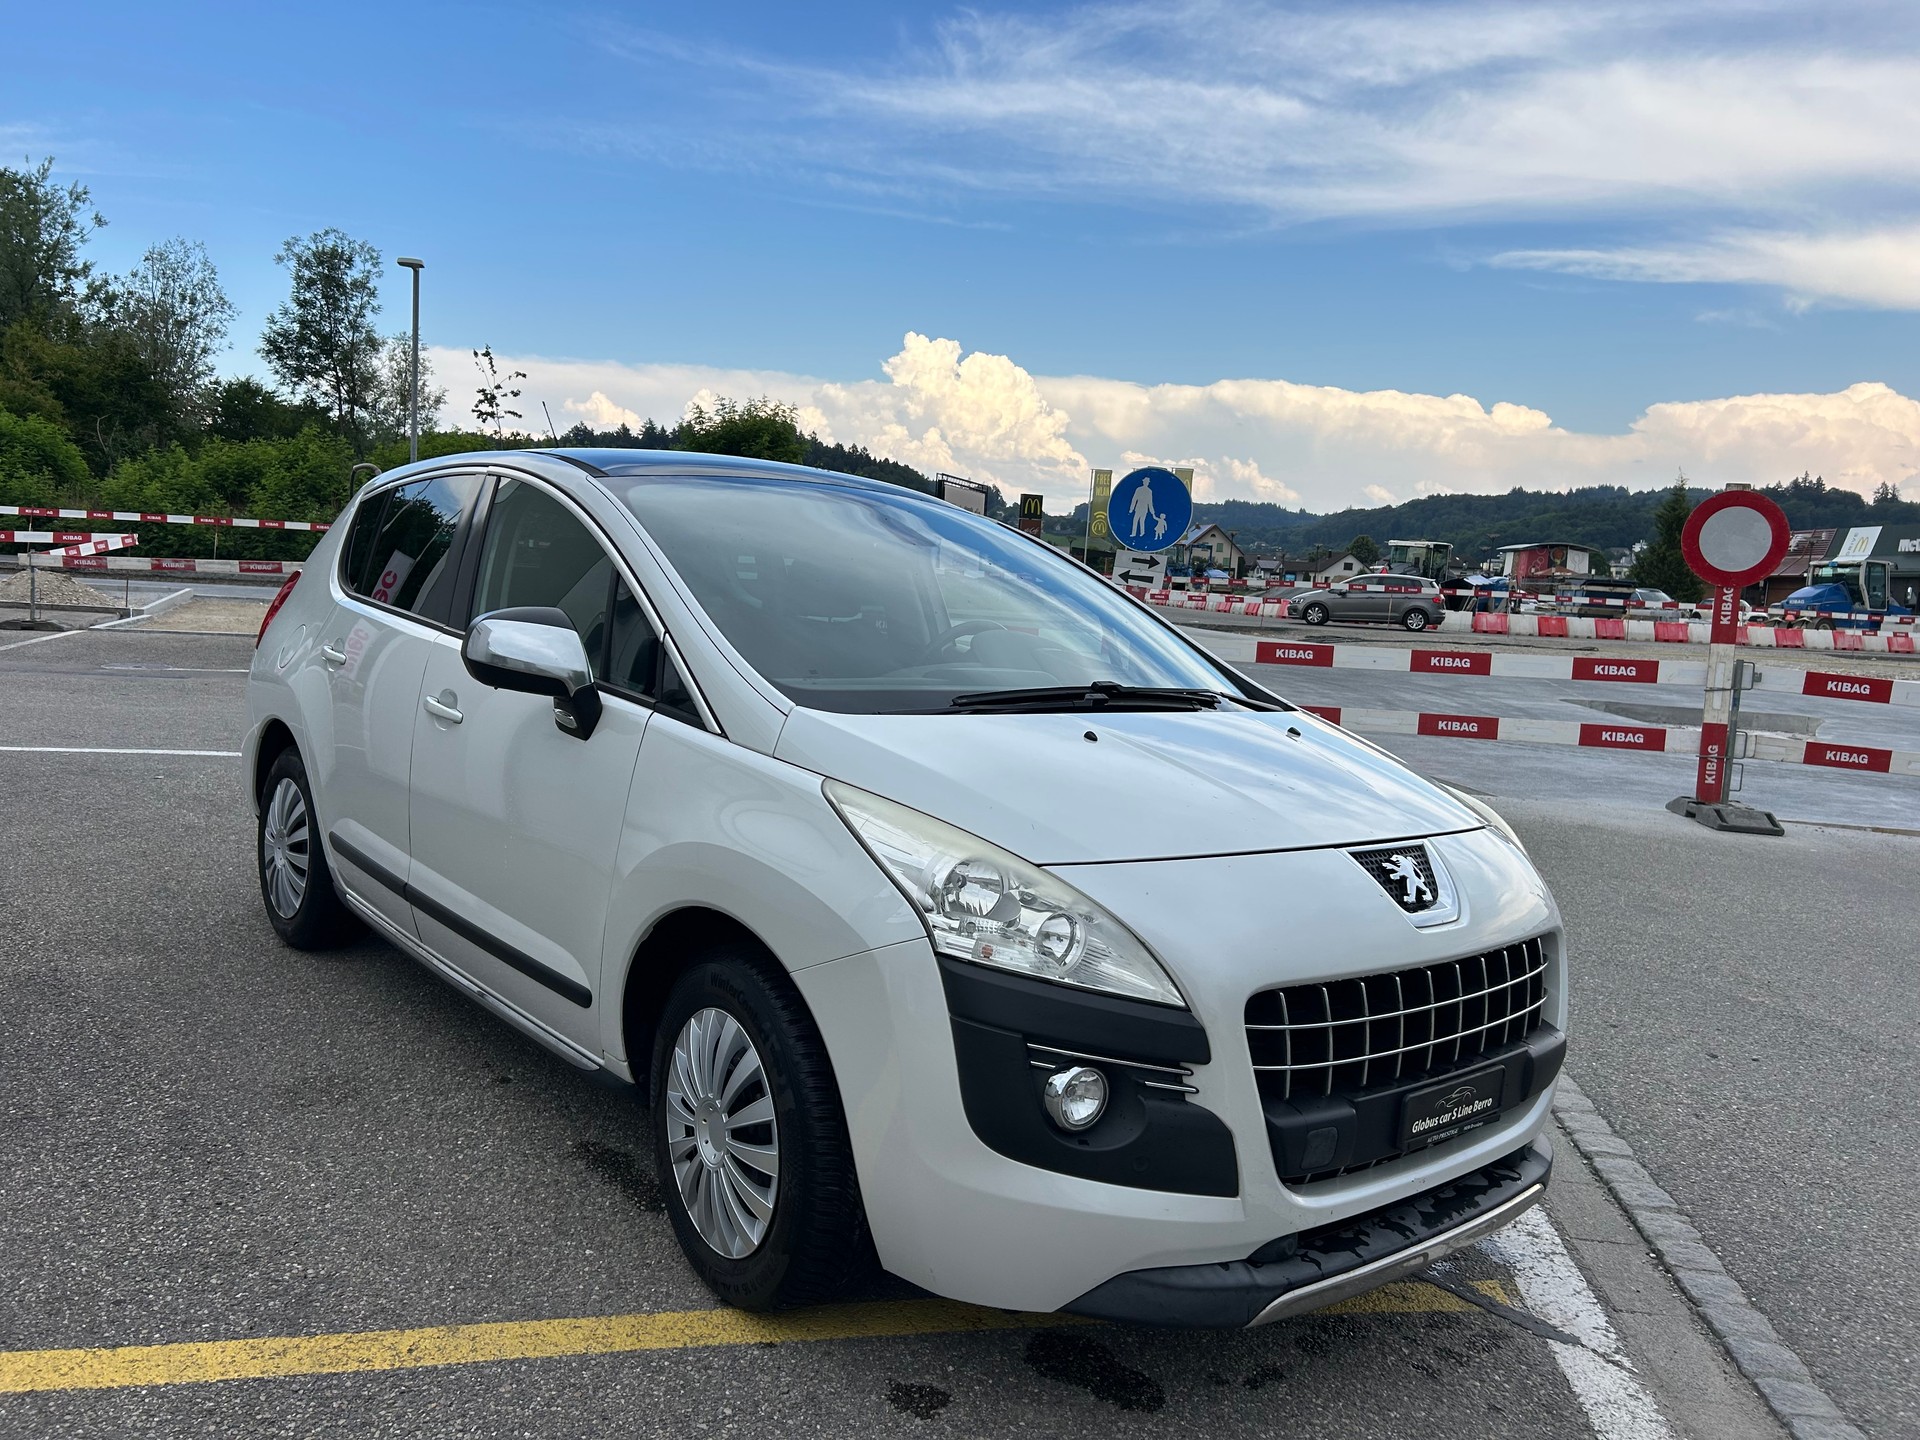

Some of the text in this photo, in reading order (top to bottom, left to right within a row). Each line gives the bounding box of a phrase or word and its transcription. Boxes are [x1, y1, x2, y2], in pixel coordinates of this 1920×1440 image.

[1096, 473, 1110, 485] FREE
[1719, 586, 1735, 625] KIBAG
[1275, 648, 1314, 660] KIBAG
[1430, 656, 1470, 669] KIBAG
[1594, 664, 1637, 678] KIBAG
[1827, 680, 1871, 696] KIBAG
[1437, 719, 1478, 733] KIBAG
[1601, 731, 1644, 745] KIBAG
[1825, 749, 1869, 764] KIBAG
[1704, 744, 1719, 785] KIBAG
[1412, 1097, 1493, 1134] Globus car S Line Berro
